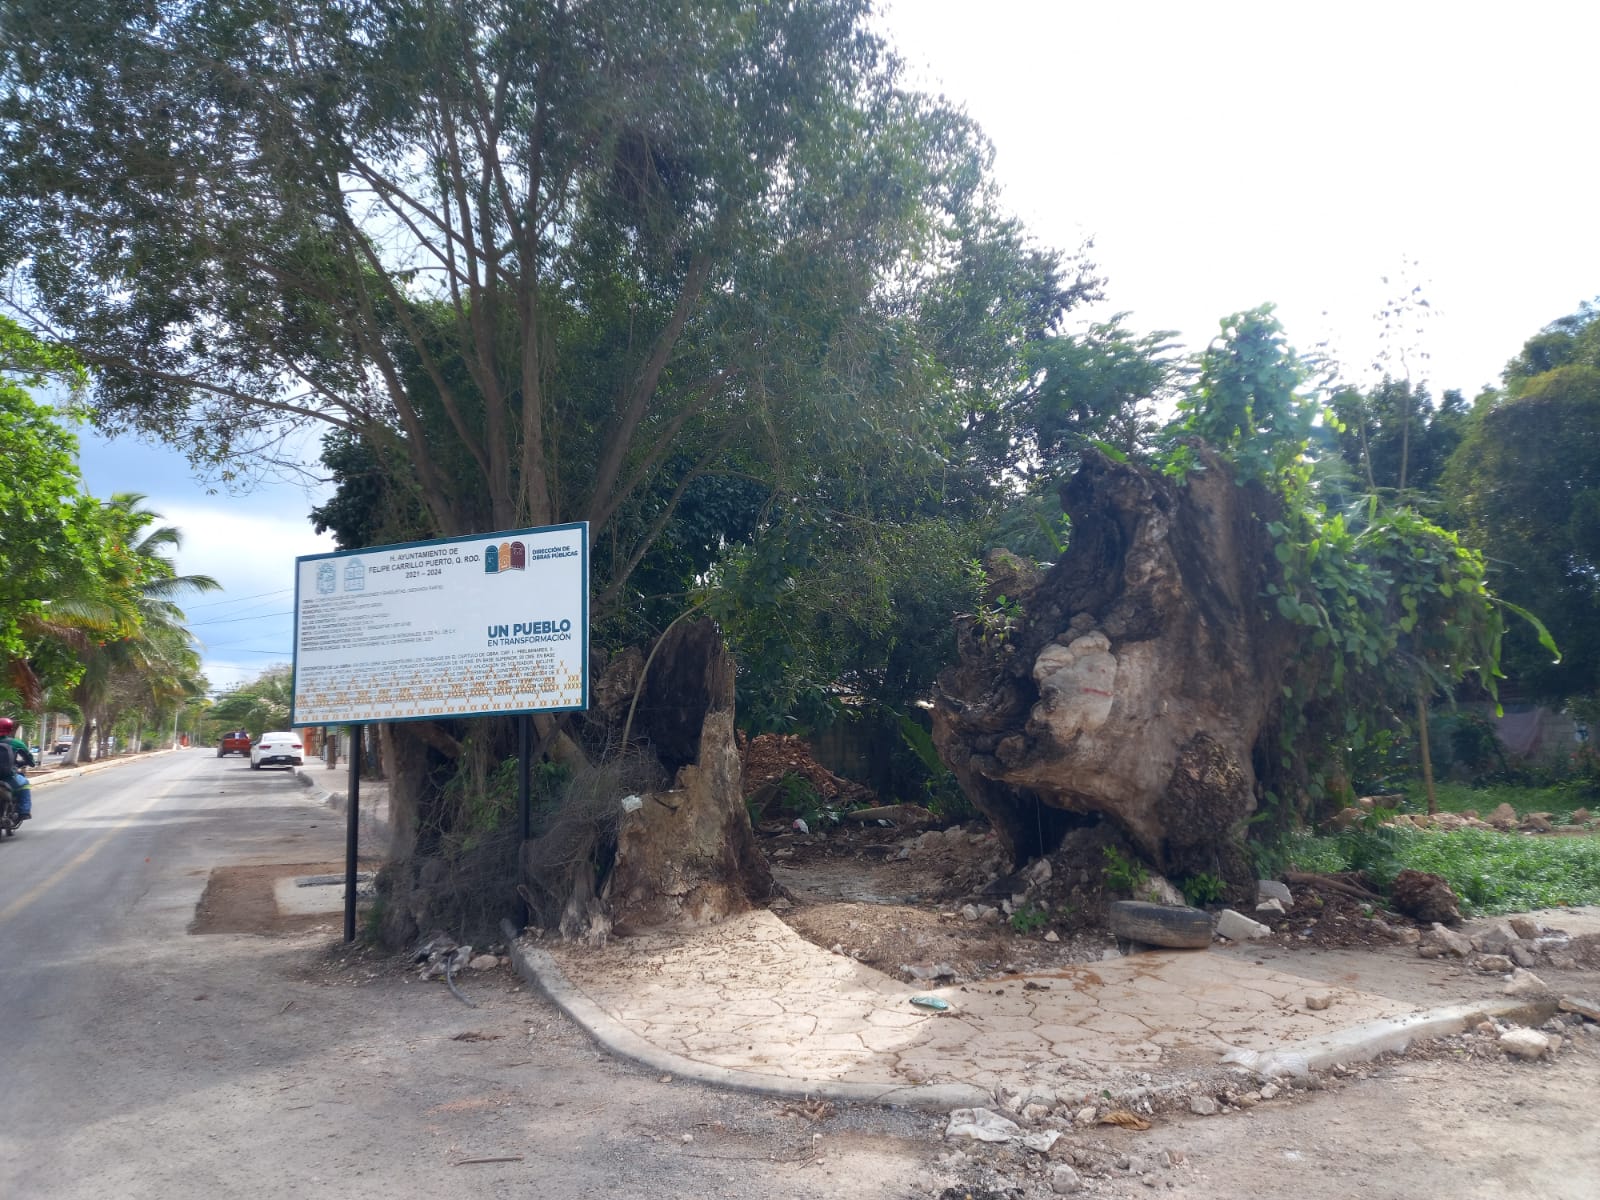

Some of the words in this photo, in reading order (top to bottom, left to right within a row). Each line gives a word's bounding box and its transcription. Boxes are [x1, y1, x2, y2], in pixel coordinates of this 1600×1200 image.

[397, 549, 448, 561] AYUNTAMIENTO
[532, 546, 562, 555] DIRECCIÓN
[532, 553, 551, 561] OBRAS
[551, 550, 578, 559] PÚBLICAS
[369, 564, 391, 574] FELIPE
[391, 561, 424, 571] CARRILLO
[405, 570, 420, 579] 2021
[488, 624, 509, 638] UN
[513, 619, 571, 636] PUEBLO
[487, 639, 498, 647] EN
[499, 632, 571, 646] TRANSFORMACIÓN
